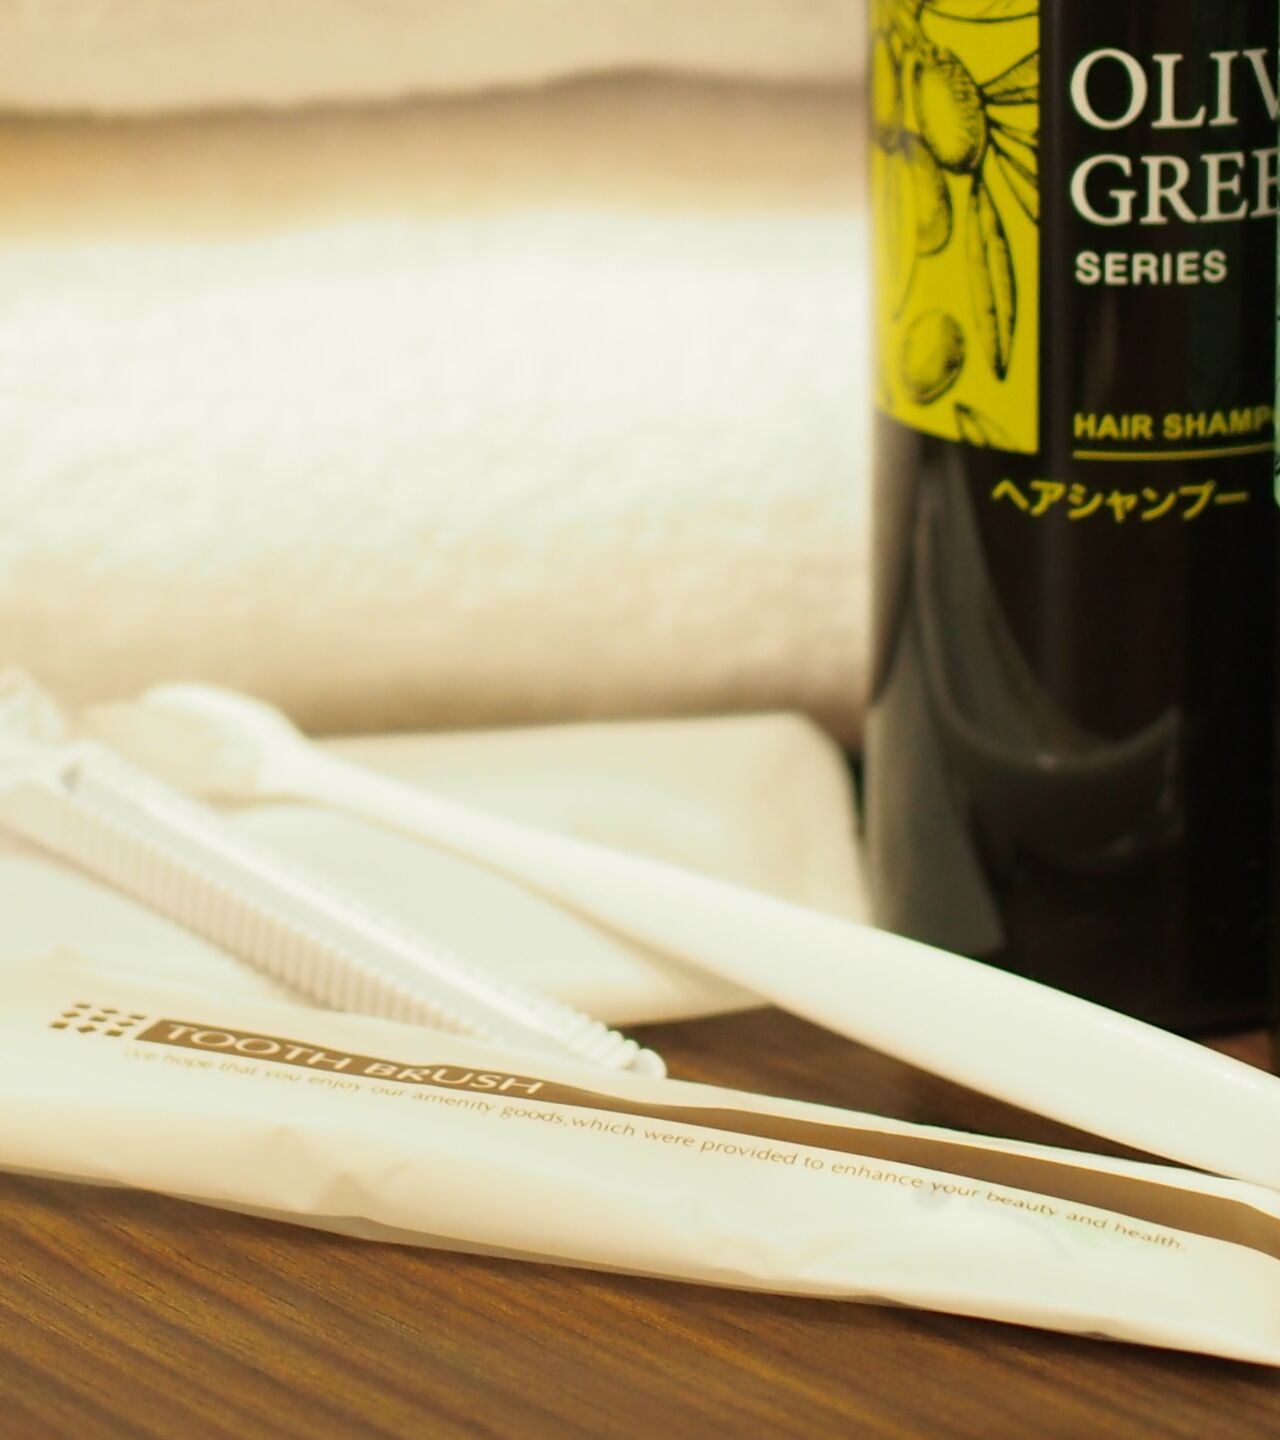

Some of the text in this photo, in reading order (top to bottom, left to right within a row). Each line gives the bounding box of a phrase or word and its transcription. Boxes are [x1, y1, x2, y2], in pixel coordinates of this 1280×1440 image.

[1070, 46, 1280, 131] OLIV
[1070, 147, 1280, 228] GREE
[1075, 249, 1228, 287] SERIES
[1073, 405, 1276, 441] HAIR SHAMP
[991, 478, 1250, 524] ヘアシャンプー
[165, 1023, 544, 1096] TOOTH BRUSH
[162, 1052, 210, 1070] hope
[219, 1062, 257, 1077] that
[264, 1069, 303, 1083] you
[307, 1076, 363, 1094] enjoy
[370, 1086, 407, 1098] our
[412, 1091, 497, 1116] amenity
[643, 1127, 696, 1148] were
[699, 1139, 799, 1166] provided
[803, 1157, 825, 1171] to
[831, 1161, 925, 1189] enhance
[929, 1178, 980, 1198] your
[986, 1190, 1059, 1217] beauty
[1066, 1210, 1108, 1230] and
[1114, 1221, 1188, 1253] health.
